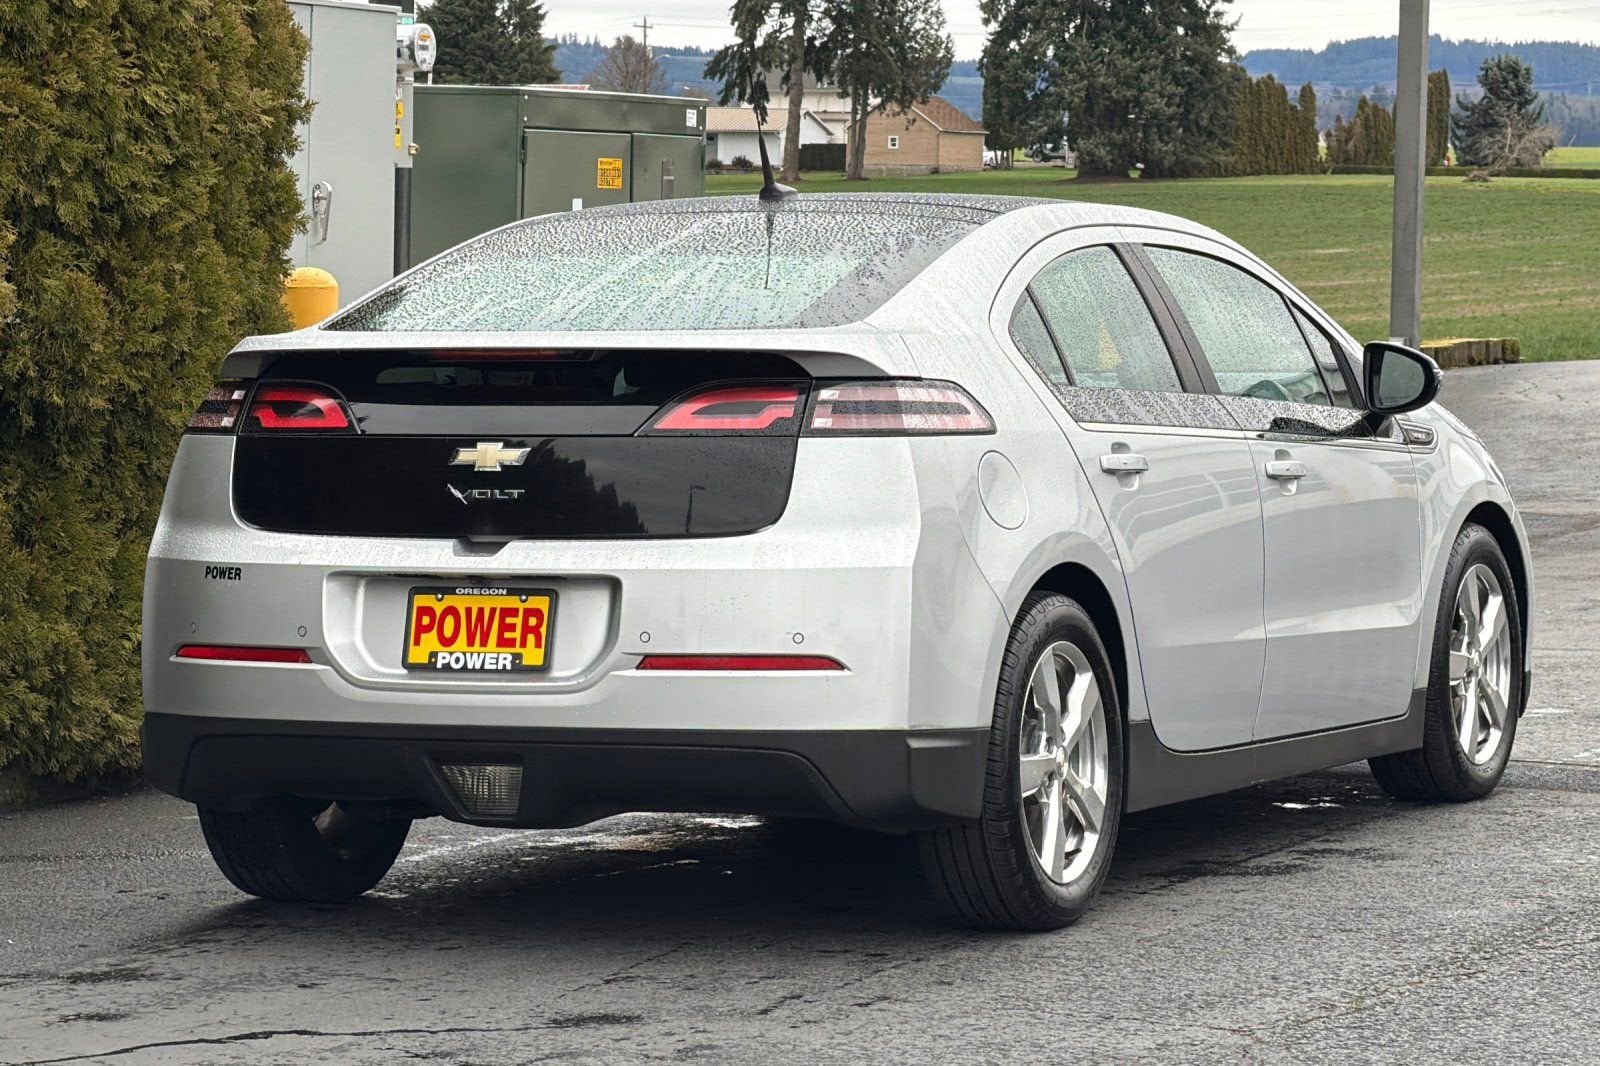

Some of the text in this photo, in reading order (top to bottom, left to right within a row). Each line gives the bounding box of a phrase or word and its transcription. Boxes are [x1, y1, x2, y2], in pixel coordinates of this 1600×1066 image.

[447, 483, 525, 505] VOLT
[205, 565, 242, 581] POWER
[455, 587, 507, 596] OREGON
[413, 605, 545, 649] POWER
[436, 652, 513, 670] POWER
